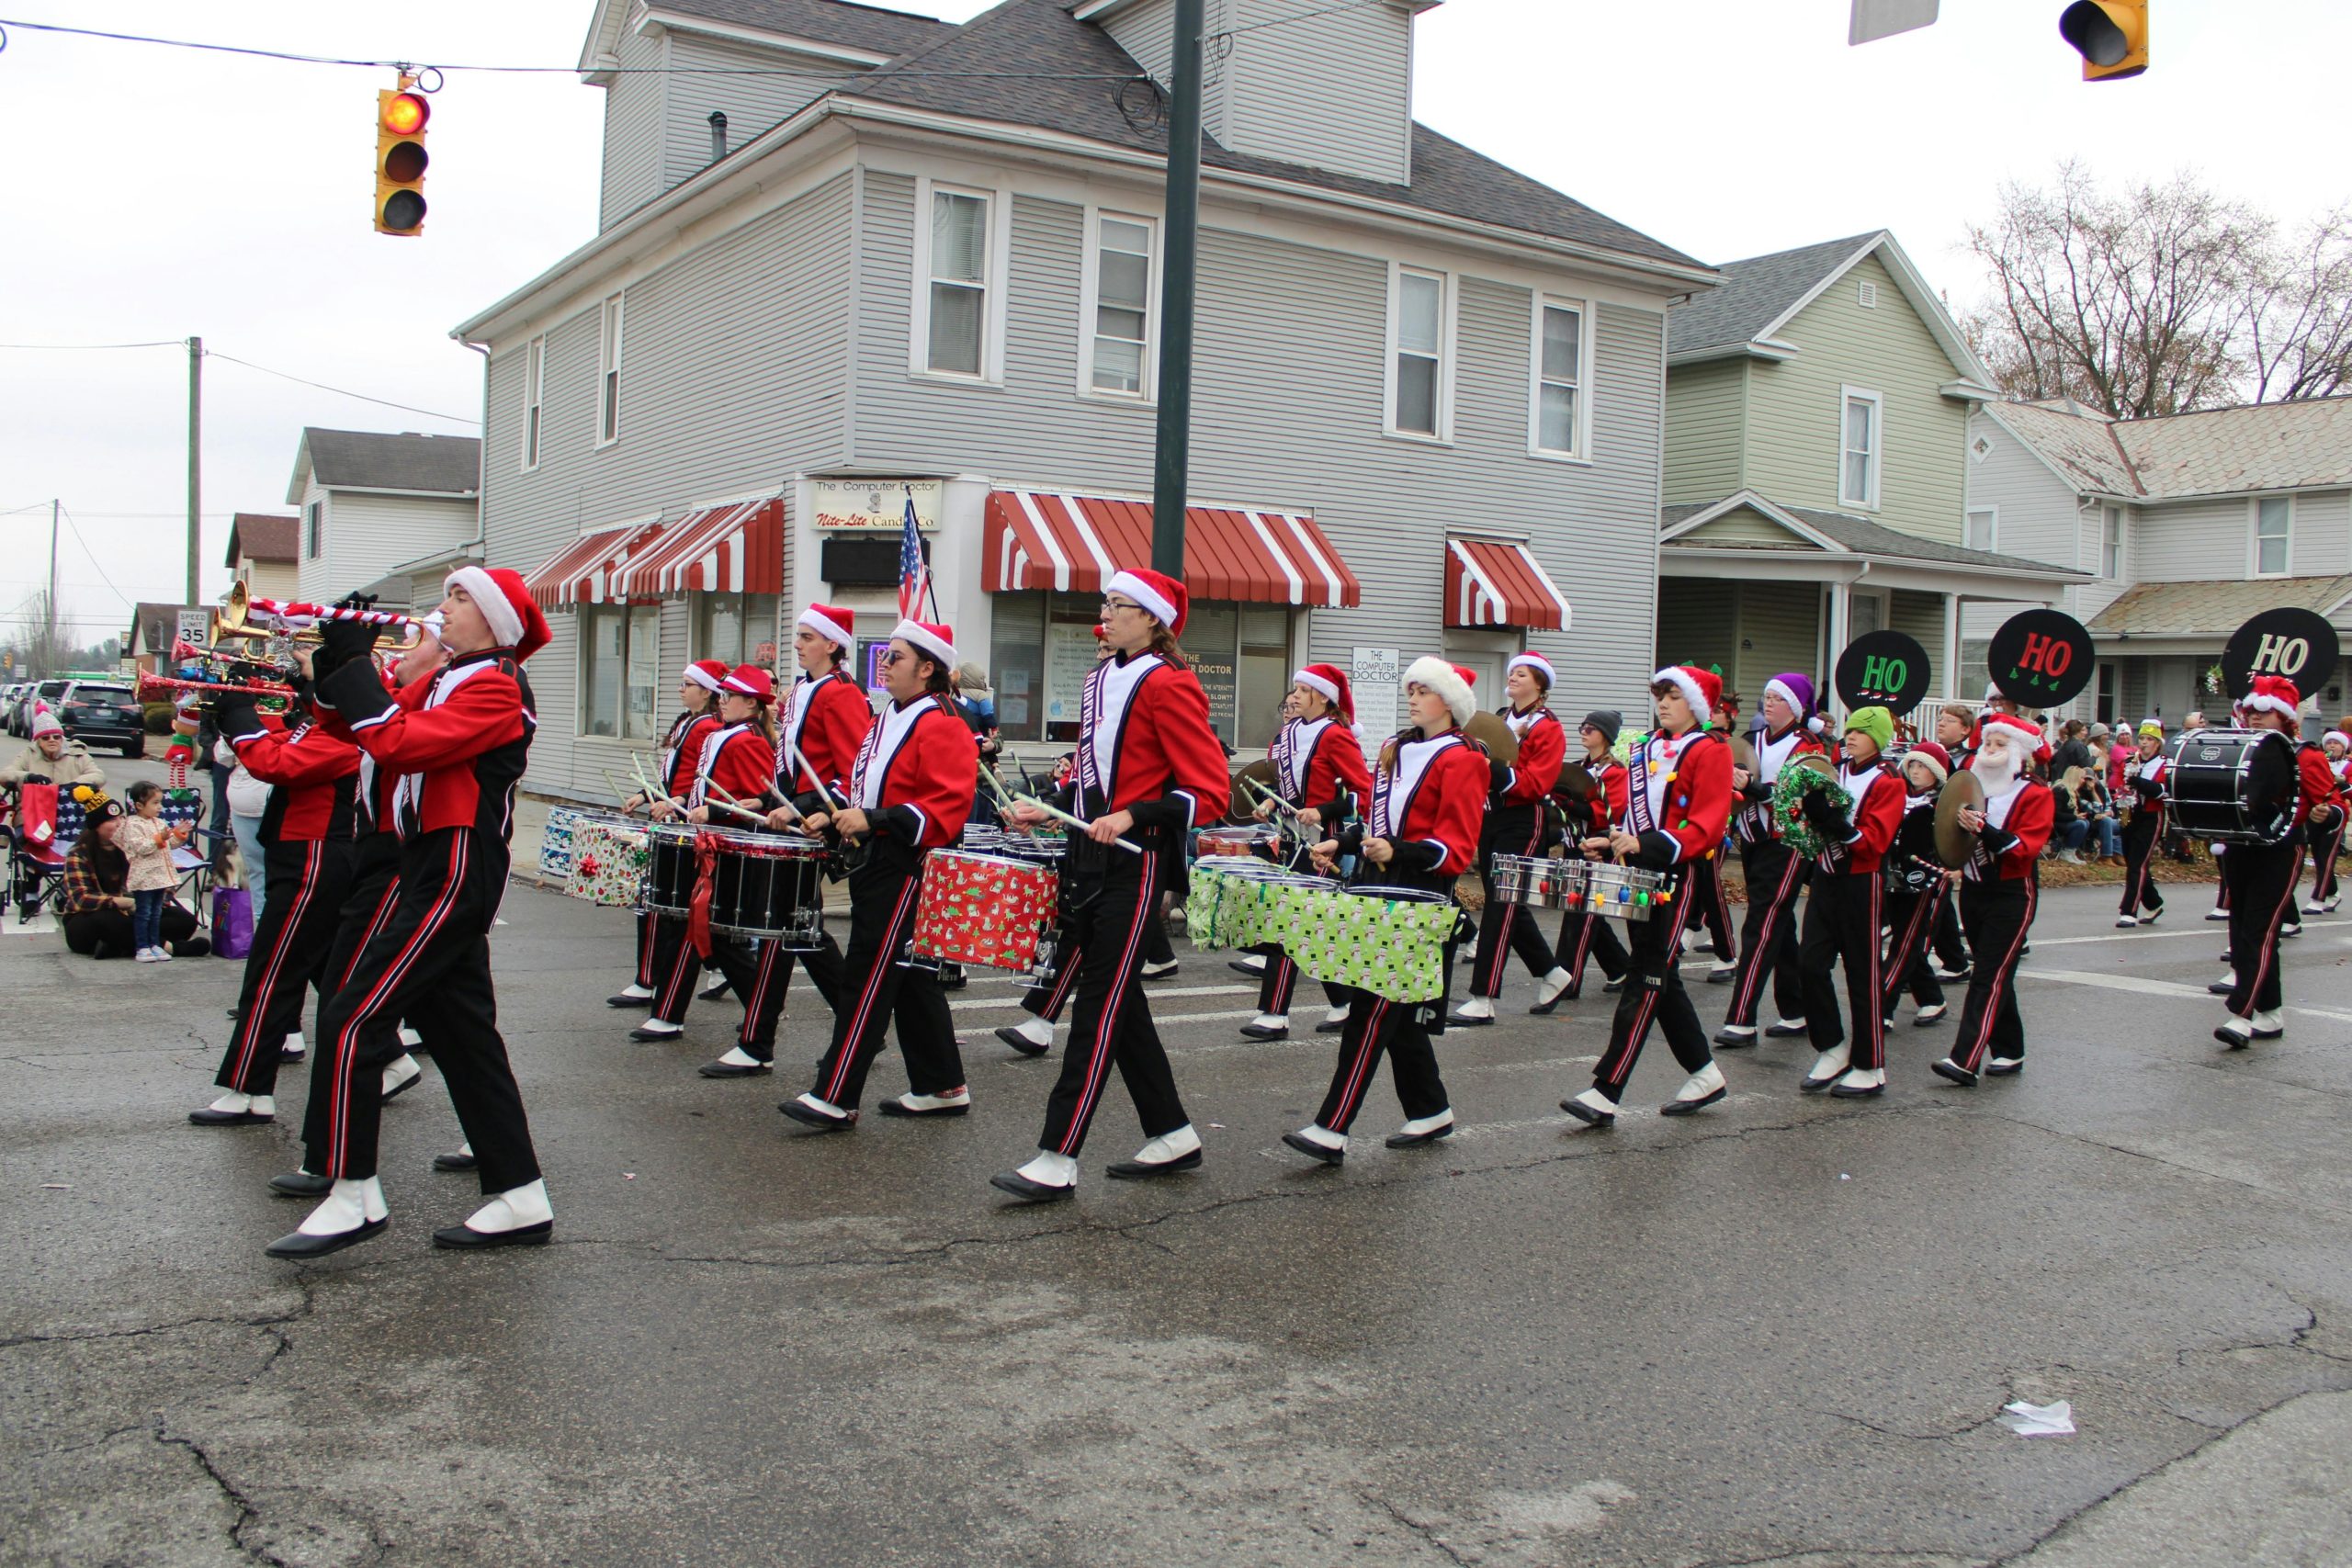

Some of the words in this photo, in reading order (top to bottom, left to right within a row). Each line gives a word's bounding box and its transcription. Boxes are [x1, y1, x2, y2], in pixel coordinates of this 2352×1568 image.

[816, 481, 836, 491] The
[842, 481, 897, 492] Computer
[899, 481, 936, 491] Doctor
[816, 513, 868, 526] Nite-Lite
[872, 515, 905, 526] Cand
[182, 628, 204, 642] 35
[1183, 654, 1201, 662] THE
[1198, 664, 1232, 675] DOCTOR
[1356, 661, 1396, 671] COMPUTER
[1371, 650, 1383, 661] THE
[2018, 632, 2073, 677] HO
[2250, 633, 2310, 675] HO
[1352, 671, 1397, 681] DOCTOR
[1861, 655, 1907, 693] HO
[1082, 670, 1098, 739] FAIRFIELD
[1080, 741, 1097, 790] UNION
[1631, 742, 1645, 792] AIIELD
[1283, 769, 1297, 801] UNION
[1374, 795, 1388, 838] UNION
[1633, 793, 1651, 832] UNION
